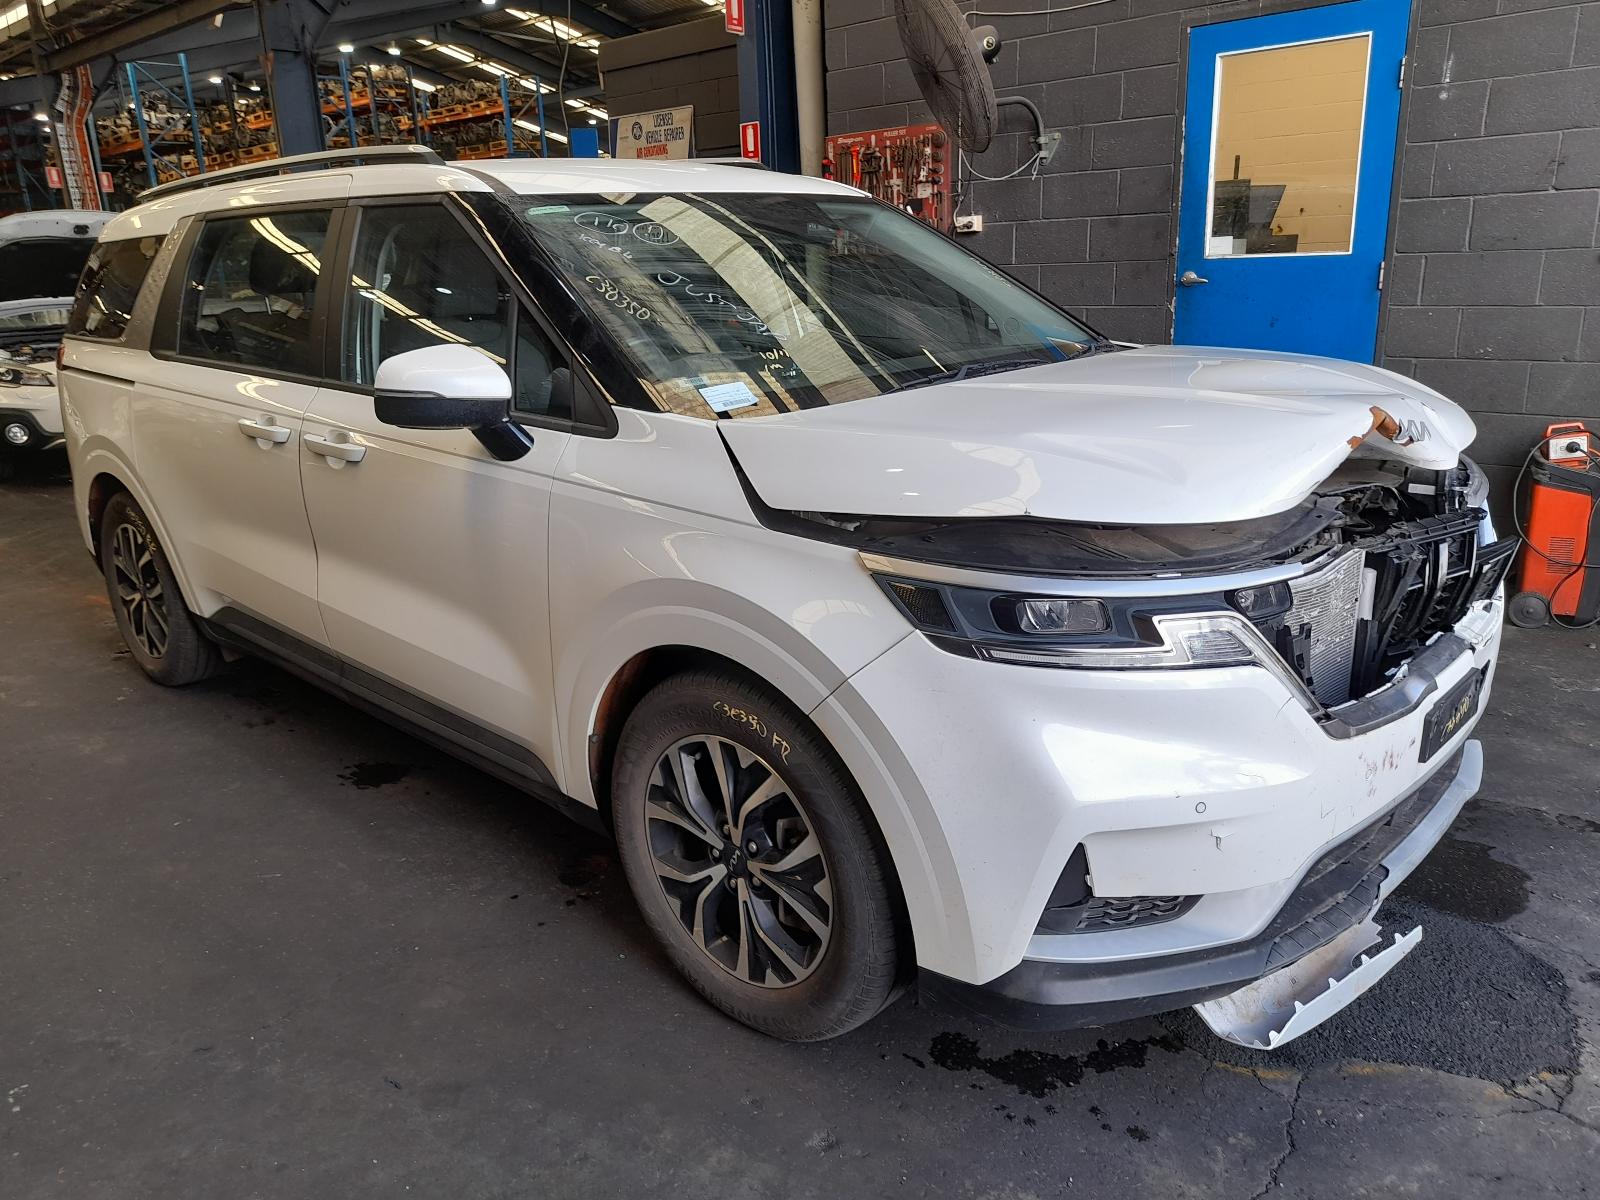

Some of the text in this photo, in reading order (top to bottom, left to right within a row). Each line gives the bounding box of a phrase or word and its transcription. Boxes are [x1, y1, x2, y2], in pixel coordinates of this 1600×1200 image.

[653, 112, 673, 127] LICENSED
[645, 126, 684, 144] VEHICLE REPAIRER
